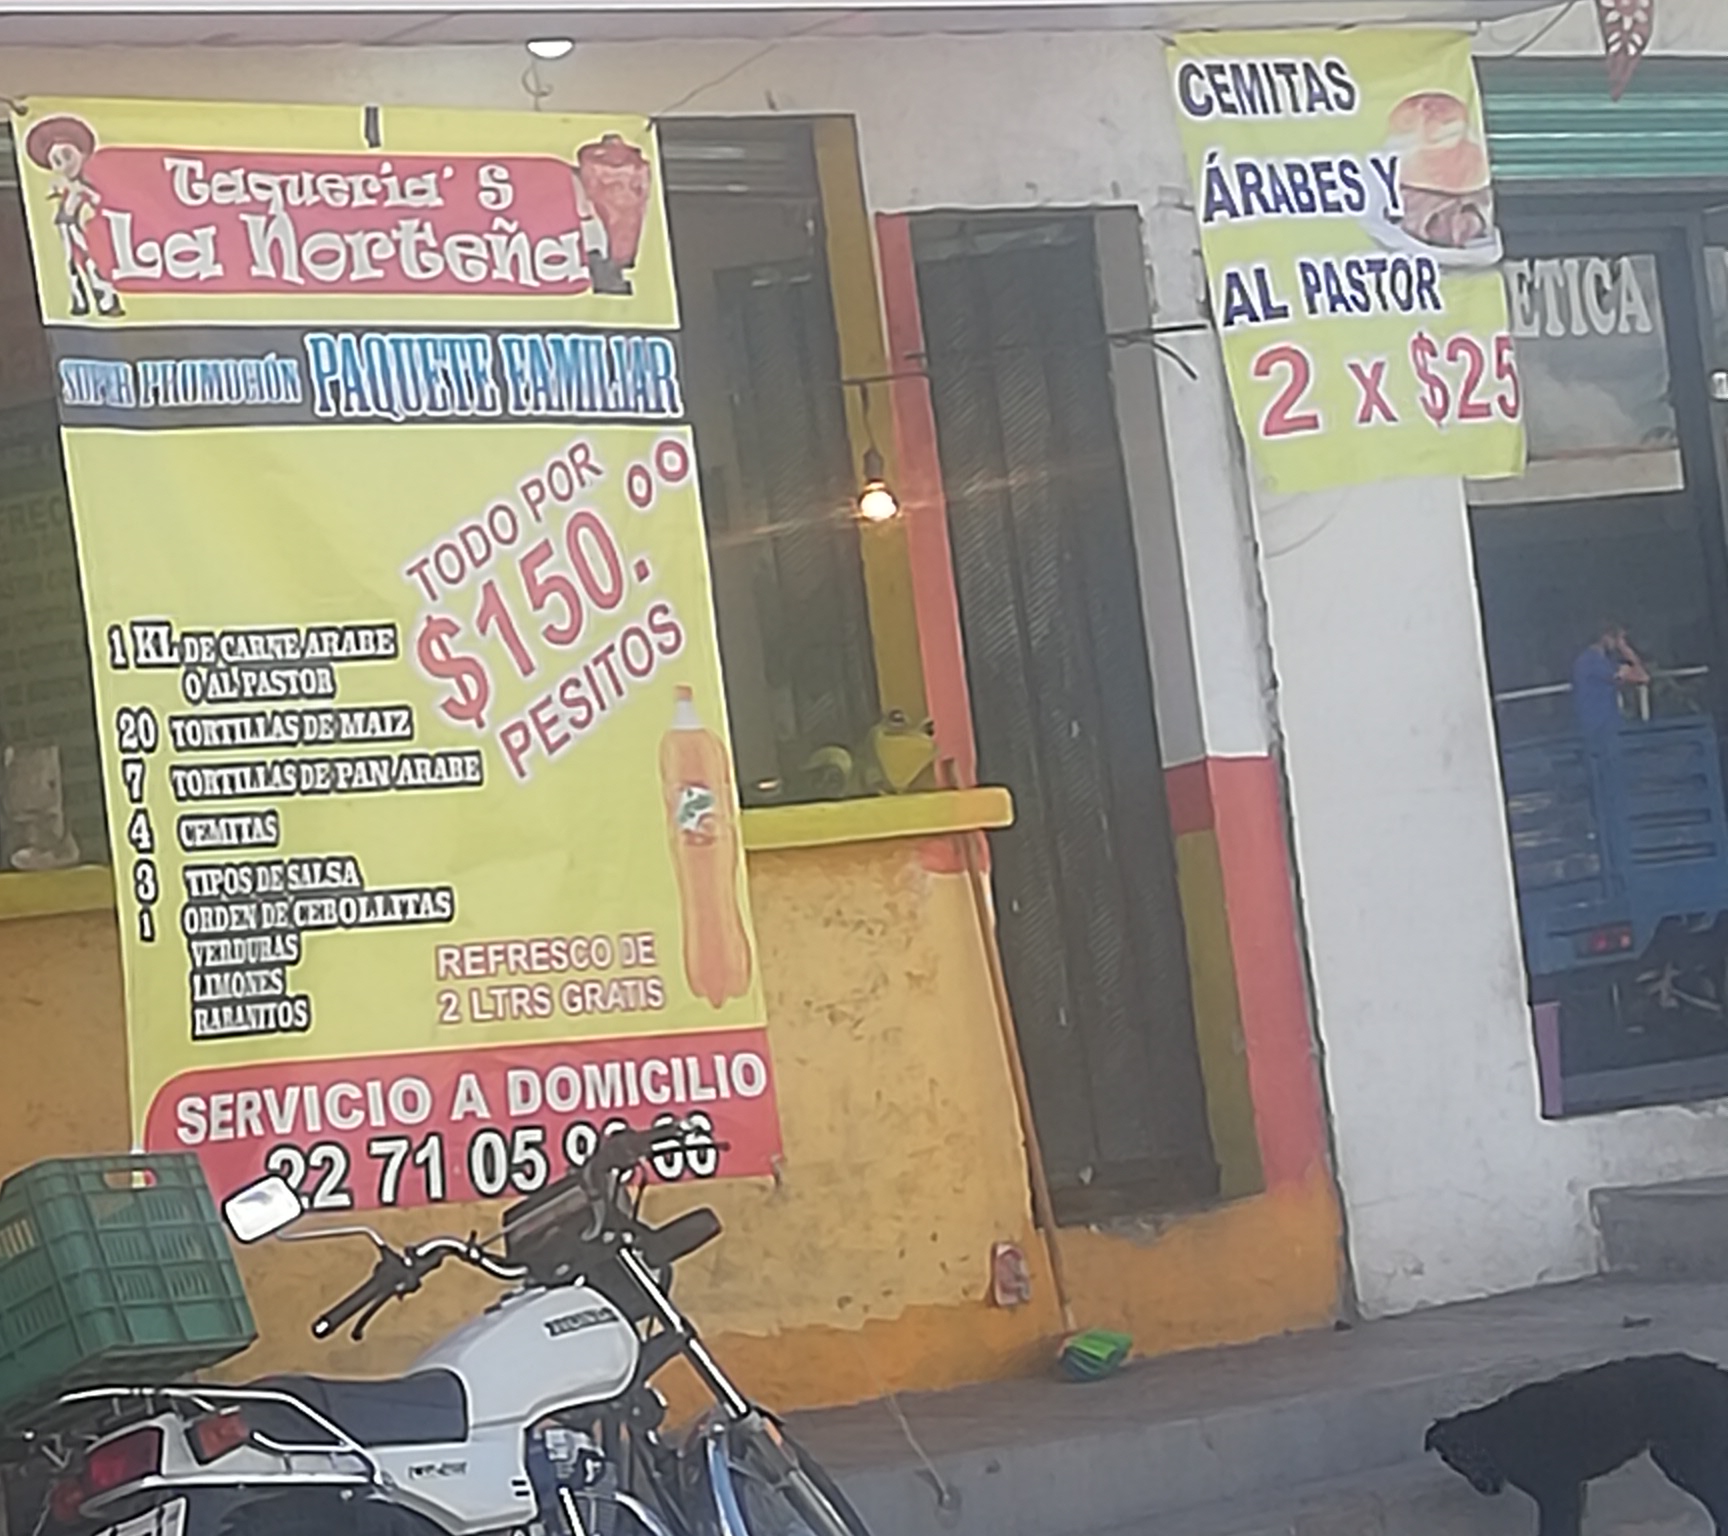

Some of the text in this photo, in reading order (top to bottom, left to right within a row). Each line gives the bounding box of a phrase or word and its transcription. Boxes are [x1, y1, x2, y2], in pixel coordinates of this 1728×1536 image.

[1178, 59, 1355, 117] CEMITAS
[1203, 152, 1406, 224] ÁRABES Y
[101, 208, 223, 282] La
[1222, 255, 1442, 328] AL PASTOR
[305, 332, 501, 422] PAQUETE
[501, 334, 684, 419] FAMILIAR
[1254, 345, 1321, 438] 2
[1410, 332, 1521, 428] $25
[406, 442, 603, 602] TODO POR
[109, 625, 126, 666] 1
[184, 636, 215, 663] DE
[220, 631, 301, 662] CARNE
[305, 627, 395, 659] ARABE
[185, 667, 335, 701] O AL PASTOR
[500, 603, 683, 778] PESITOS
[118, 709, 412, 750] 20 TORTILLAS DE MAIZ
[125, 754, 481, 799] 7 TORTILLAS DE PAN ARABE
[129, 812, 277, 851] 4 CEMITAS
[135, 860, 359, 900] 3 TIPOS DE SALSA
[140, 891, 452, 939] 1 ORDEN DE CEBOLLITAS
[191, 934, 299, 968] VERDURAS
[436, 932, 657, 980] REFRESCO DE
[193, 968, 284, 1002] LIMONES
[439, 976, 665, 1023] 2 LTRS GRATIS
[194, 1000, 309, 1037] RABANITOS
[176, 1051, 769, 1145] SERVICIO A DOMICILIO
[368, 1134, 447, 1205] 71
[467, 1127, 548, 1199] 05
